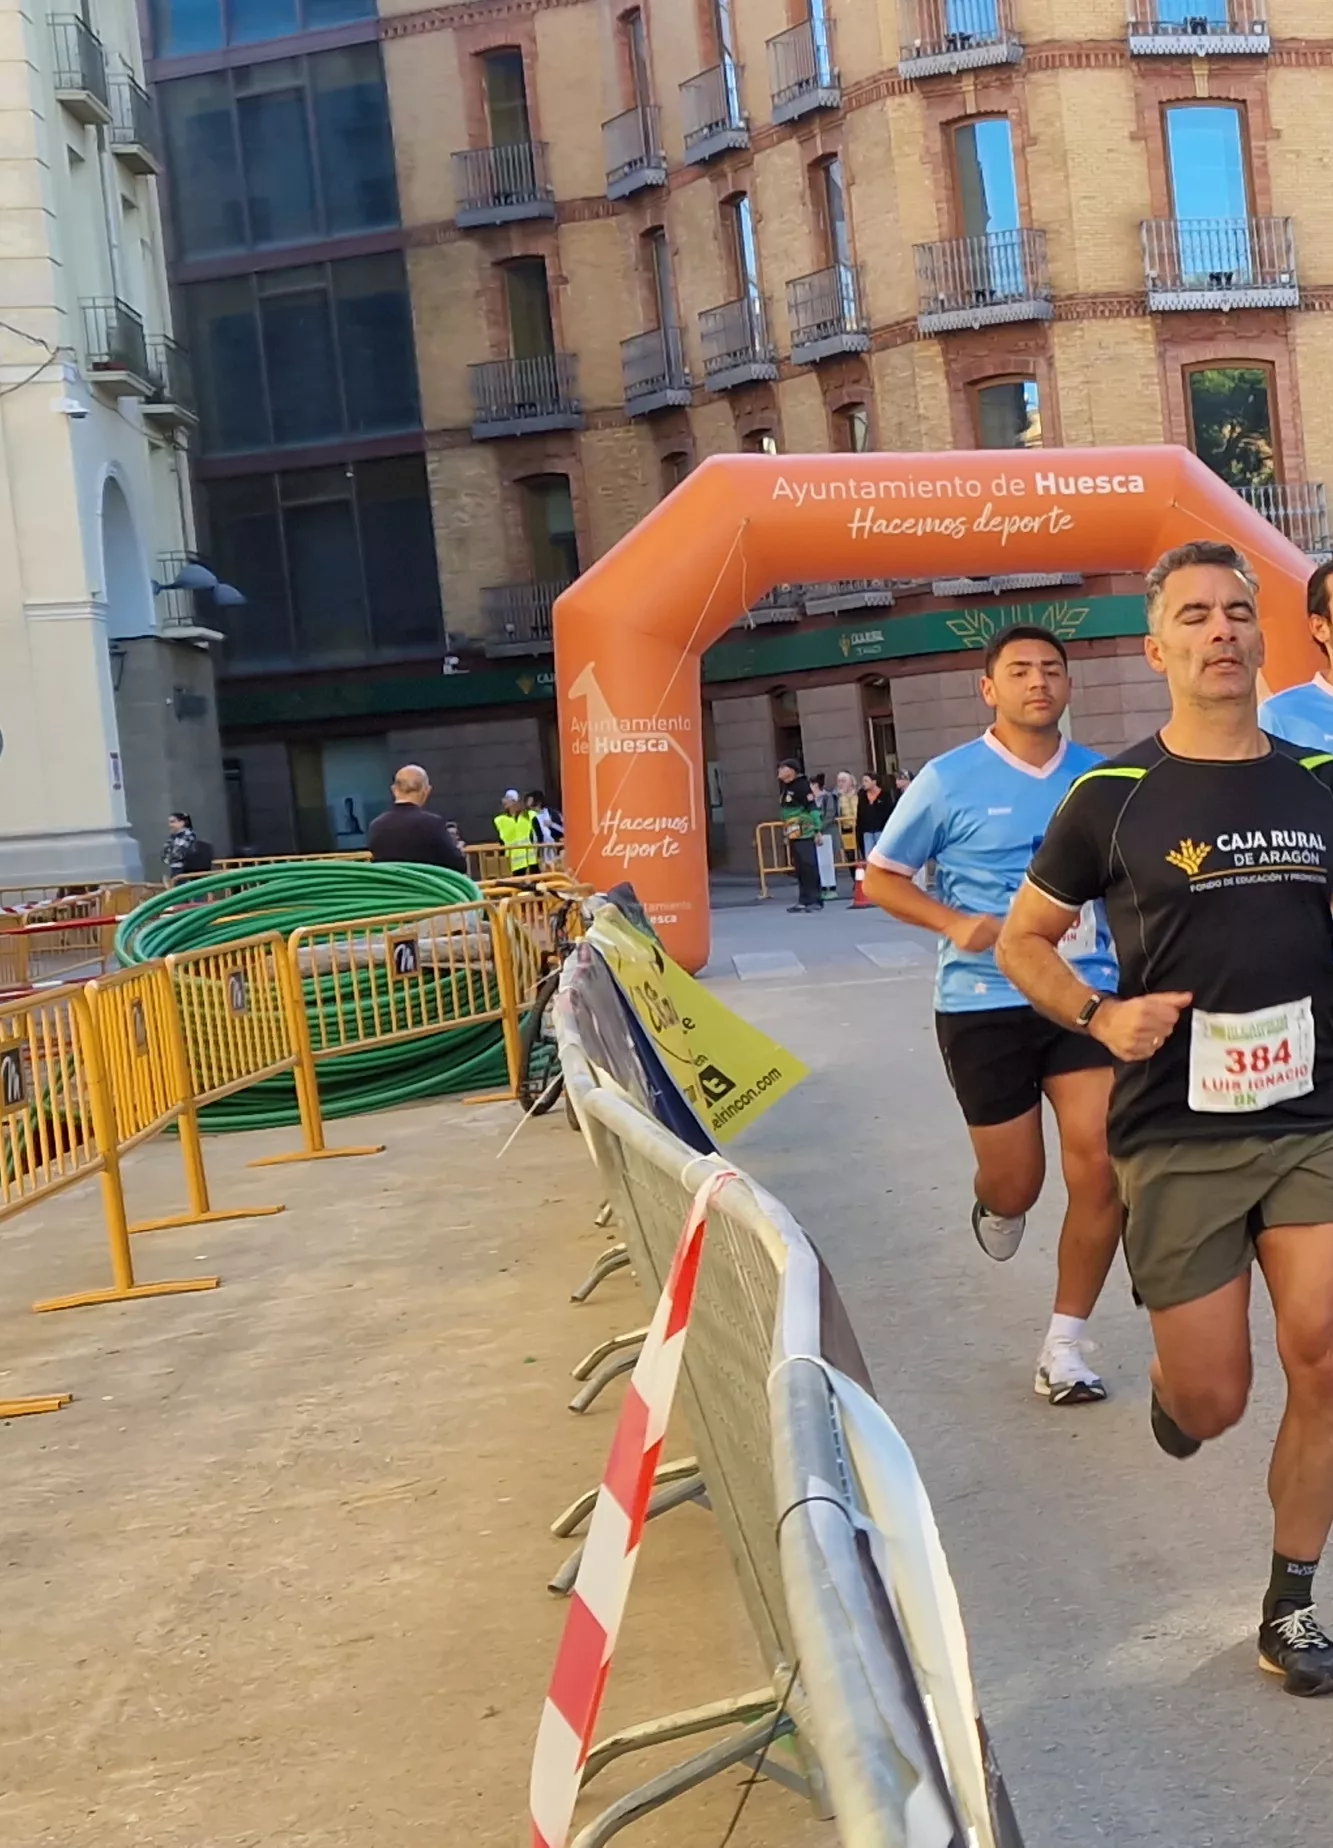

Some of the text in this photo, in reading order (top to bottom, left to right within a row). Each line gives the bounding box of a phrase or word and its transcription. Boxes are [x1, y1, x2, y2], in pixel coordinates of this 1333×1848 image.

[772, 472, 1144, 507] Ayuntamiento de Huesca
[847, 502, 1074, 546] Hacemos deporte
[570, 716, 692, 738] Ayuntamiento
[571, 737, 669, 754] de Huesca
[600, 808, 690, 835] Hacemos
[601, 832, 680, 869] deporte
[1216, 830, 1326, 852] CAJA RURAL
[1233, 849, 1320, 867] DE ARAGÓN
[650, 914, 678, 924] esca
[1223, 1036, 1293, 1076] 384
[1201, 1063, 1309, 1093] LUIS IGNACIO
